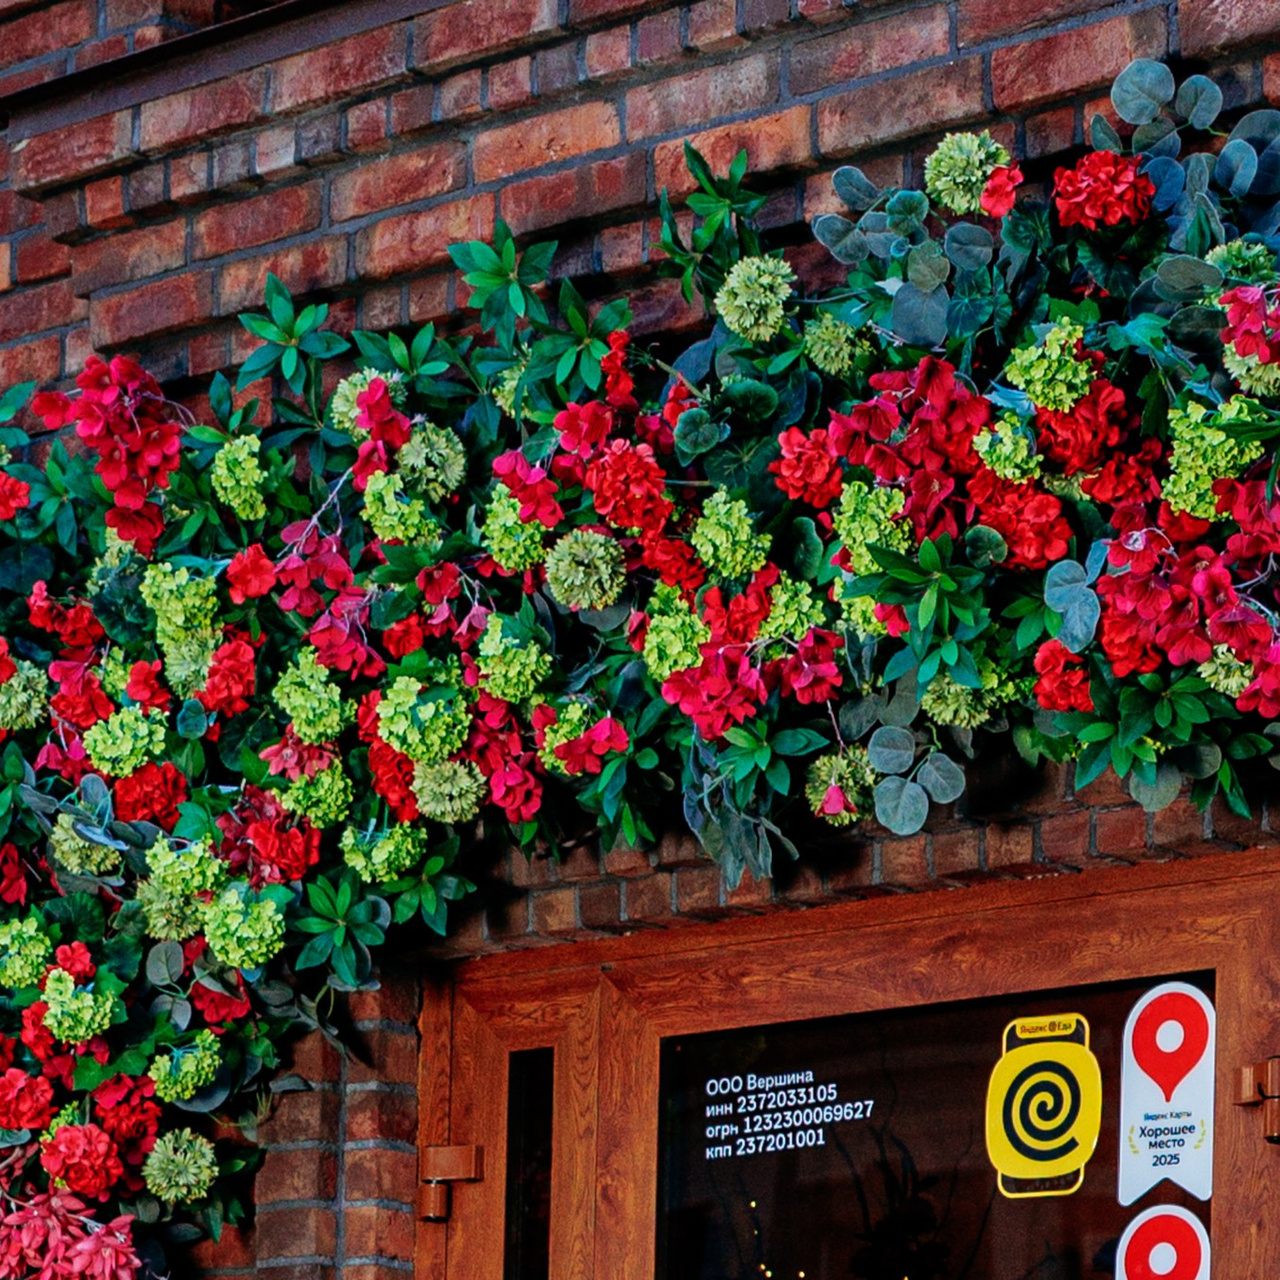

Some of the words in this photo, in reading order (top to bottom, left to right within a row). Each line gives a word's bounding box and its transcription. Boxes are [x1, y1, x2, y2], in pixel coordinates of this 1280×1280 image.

[705, 1076, 743, 1096] ООО
[746, 1070, 814, 1091] Вершина
[705, 1102, 733, 1117] инн
[737, 1083, 838, 1113] 2372033105
[705, 1123, 739, 1140] огрн
[743, 1100, 874, 1134] 1232300069627
[1139, 1124, 1196, 1139] Хорошее
[705, 1145, 732, 1160] кпп
[736, 1128, 825, 1155] 237201001
[1148, 1138, 1185, 1150] место
[1151, 1153, 1181, 1167] 2025
